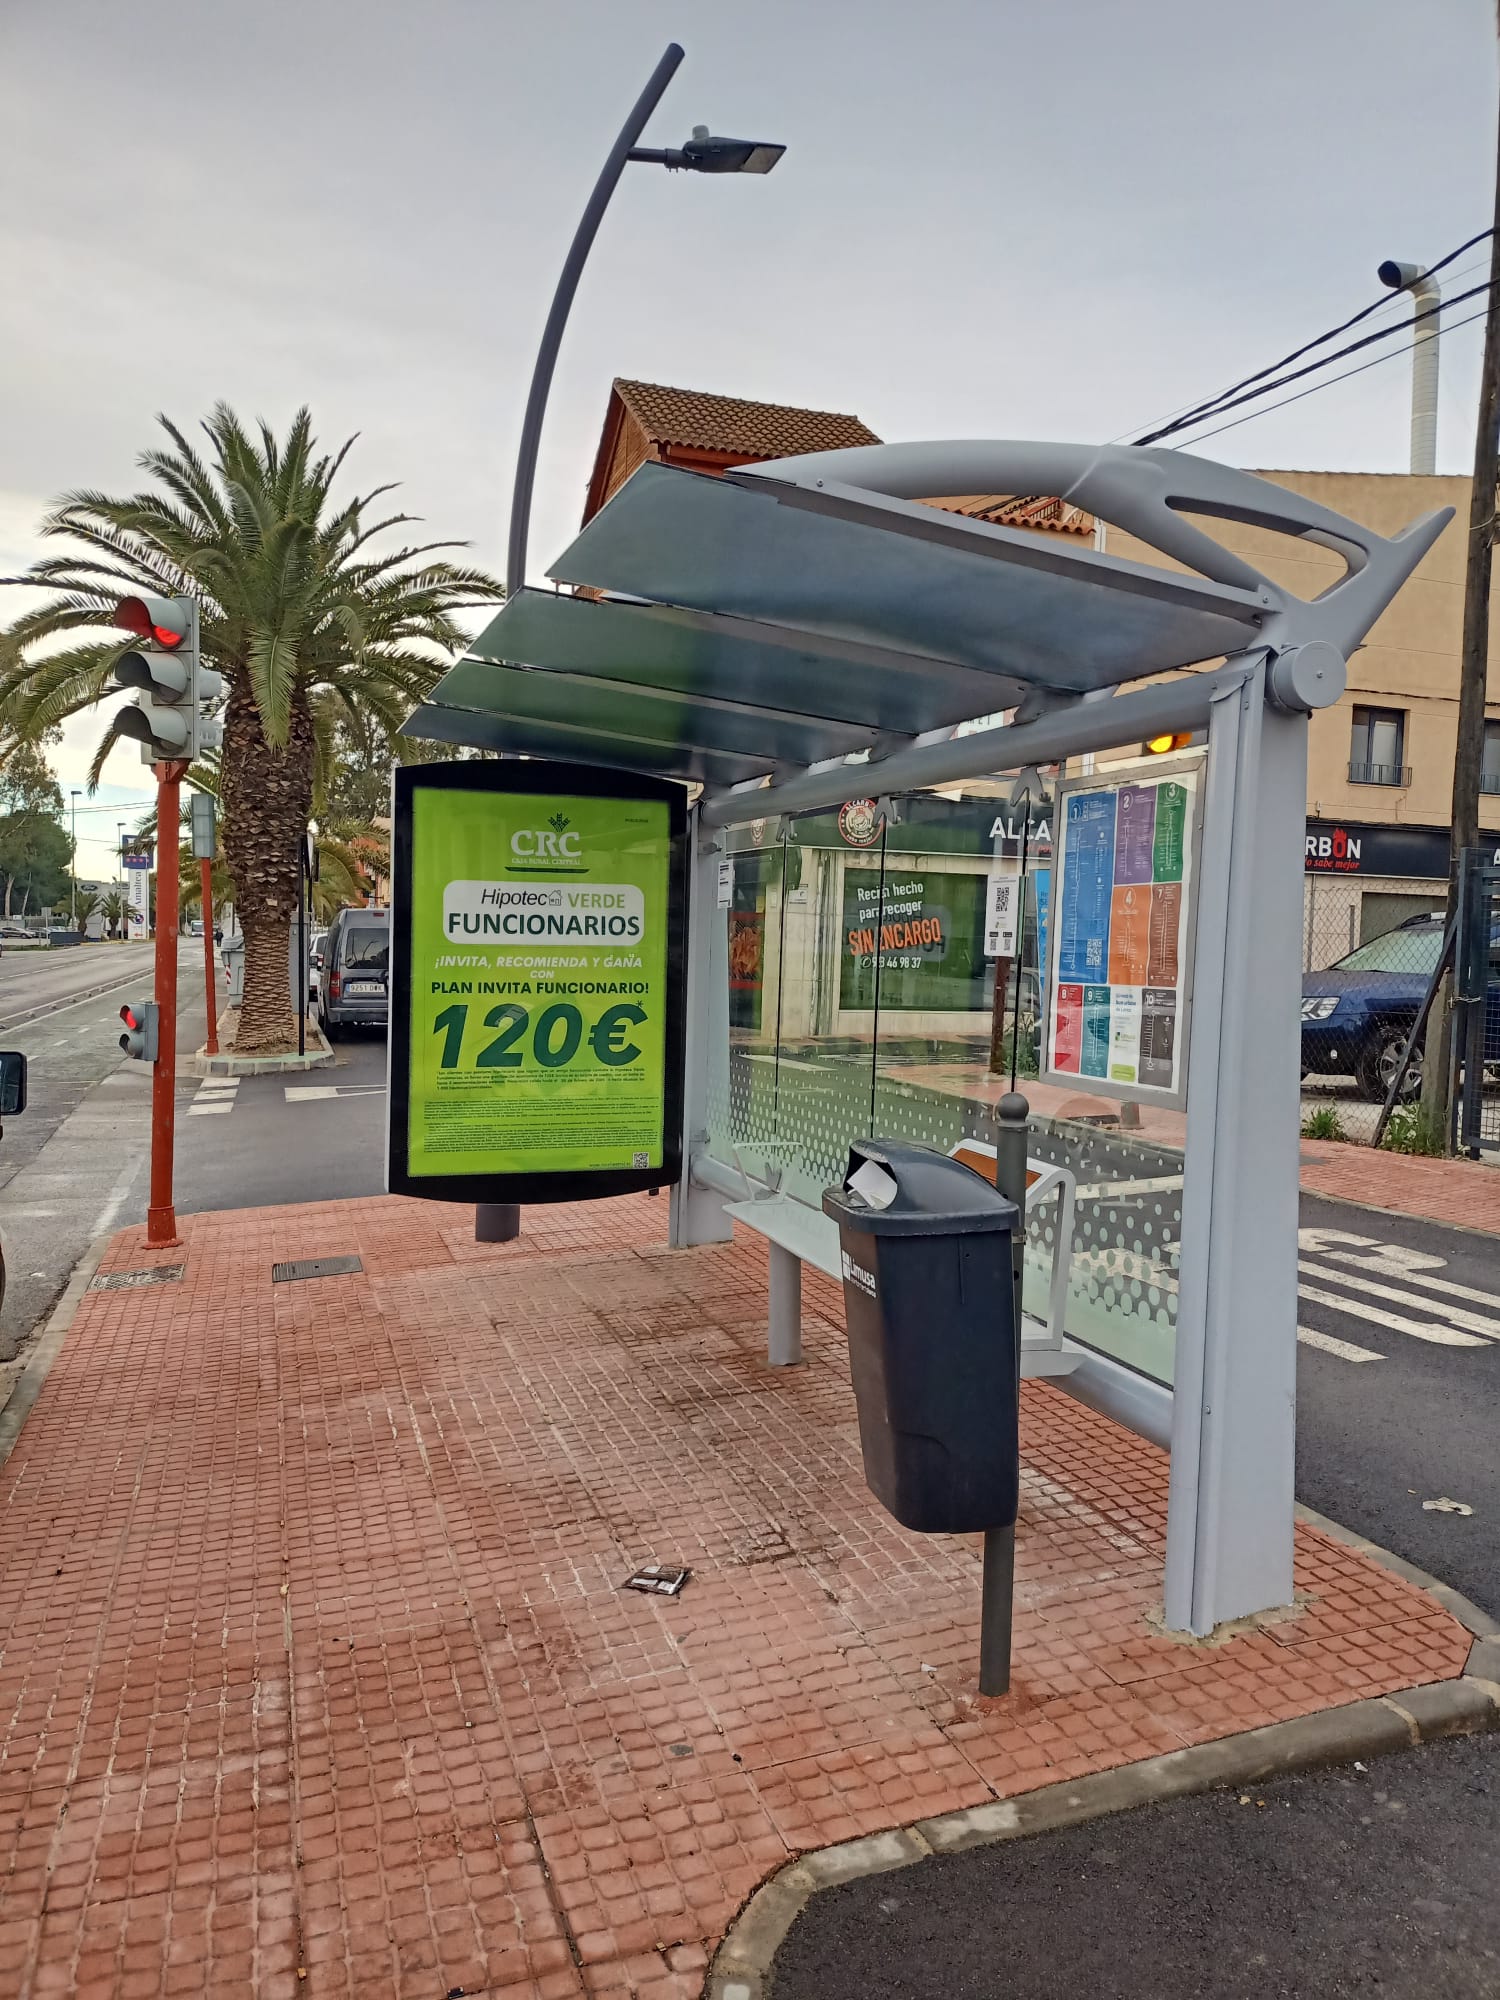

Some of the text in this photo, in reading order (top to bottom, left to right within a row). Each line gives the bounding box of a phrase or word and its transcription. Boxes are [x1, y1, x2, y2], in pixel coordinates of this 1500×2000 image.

[1123, 796, 1130, 808] 2
[510, 830, 582, 857] CRC
[1314, 858, 1333, 868] sabe
[1335, 859, 1360, 871] mejor
[892, 881, 924, 897] hecho
[568, 893, 625, 909] VERDE
[883, 900, 923, 916] recoger
[448, 913, 640, 936] FUNCIONARIOS
[849, 927, 875, 956] SIN
[496, 957, 588, 968] RECOMIENDA
[593, 957, 600, 967] Y
[887, 956, 898, 968] 46
[900, 956, 910, 968] 98
[911, 956, 921, 968] 37
[530, 970, 554, 979] CON
[431, 981, 649, 994] PLAN INVITA FUNCIONARIO!
